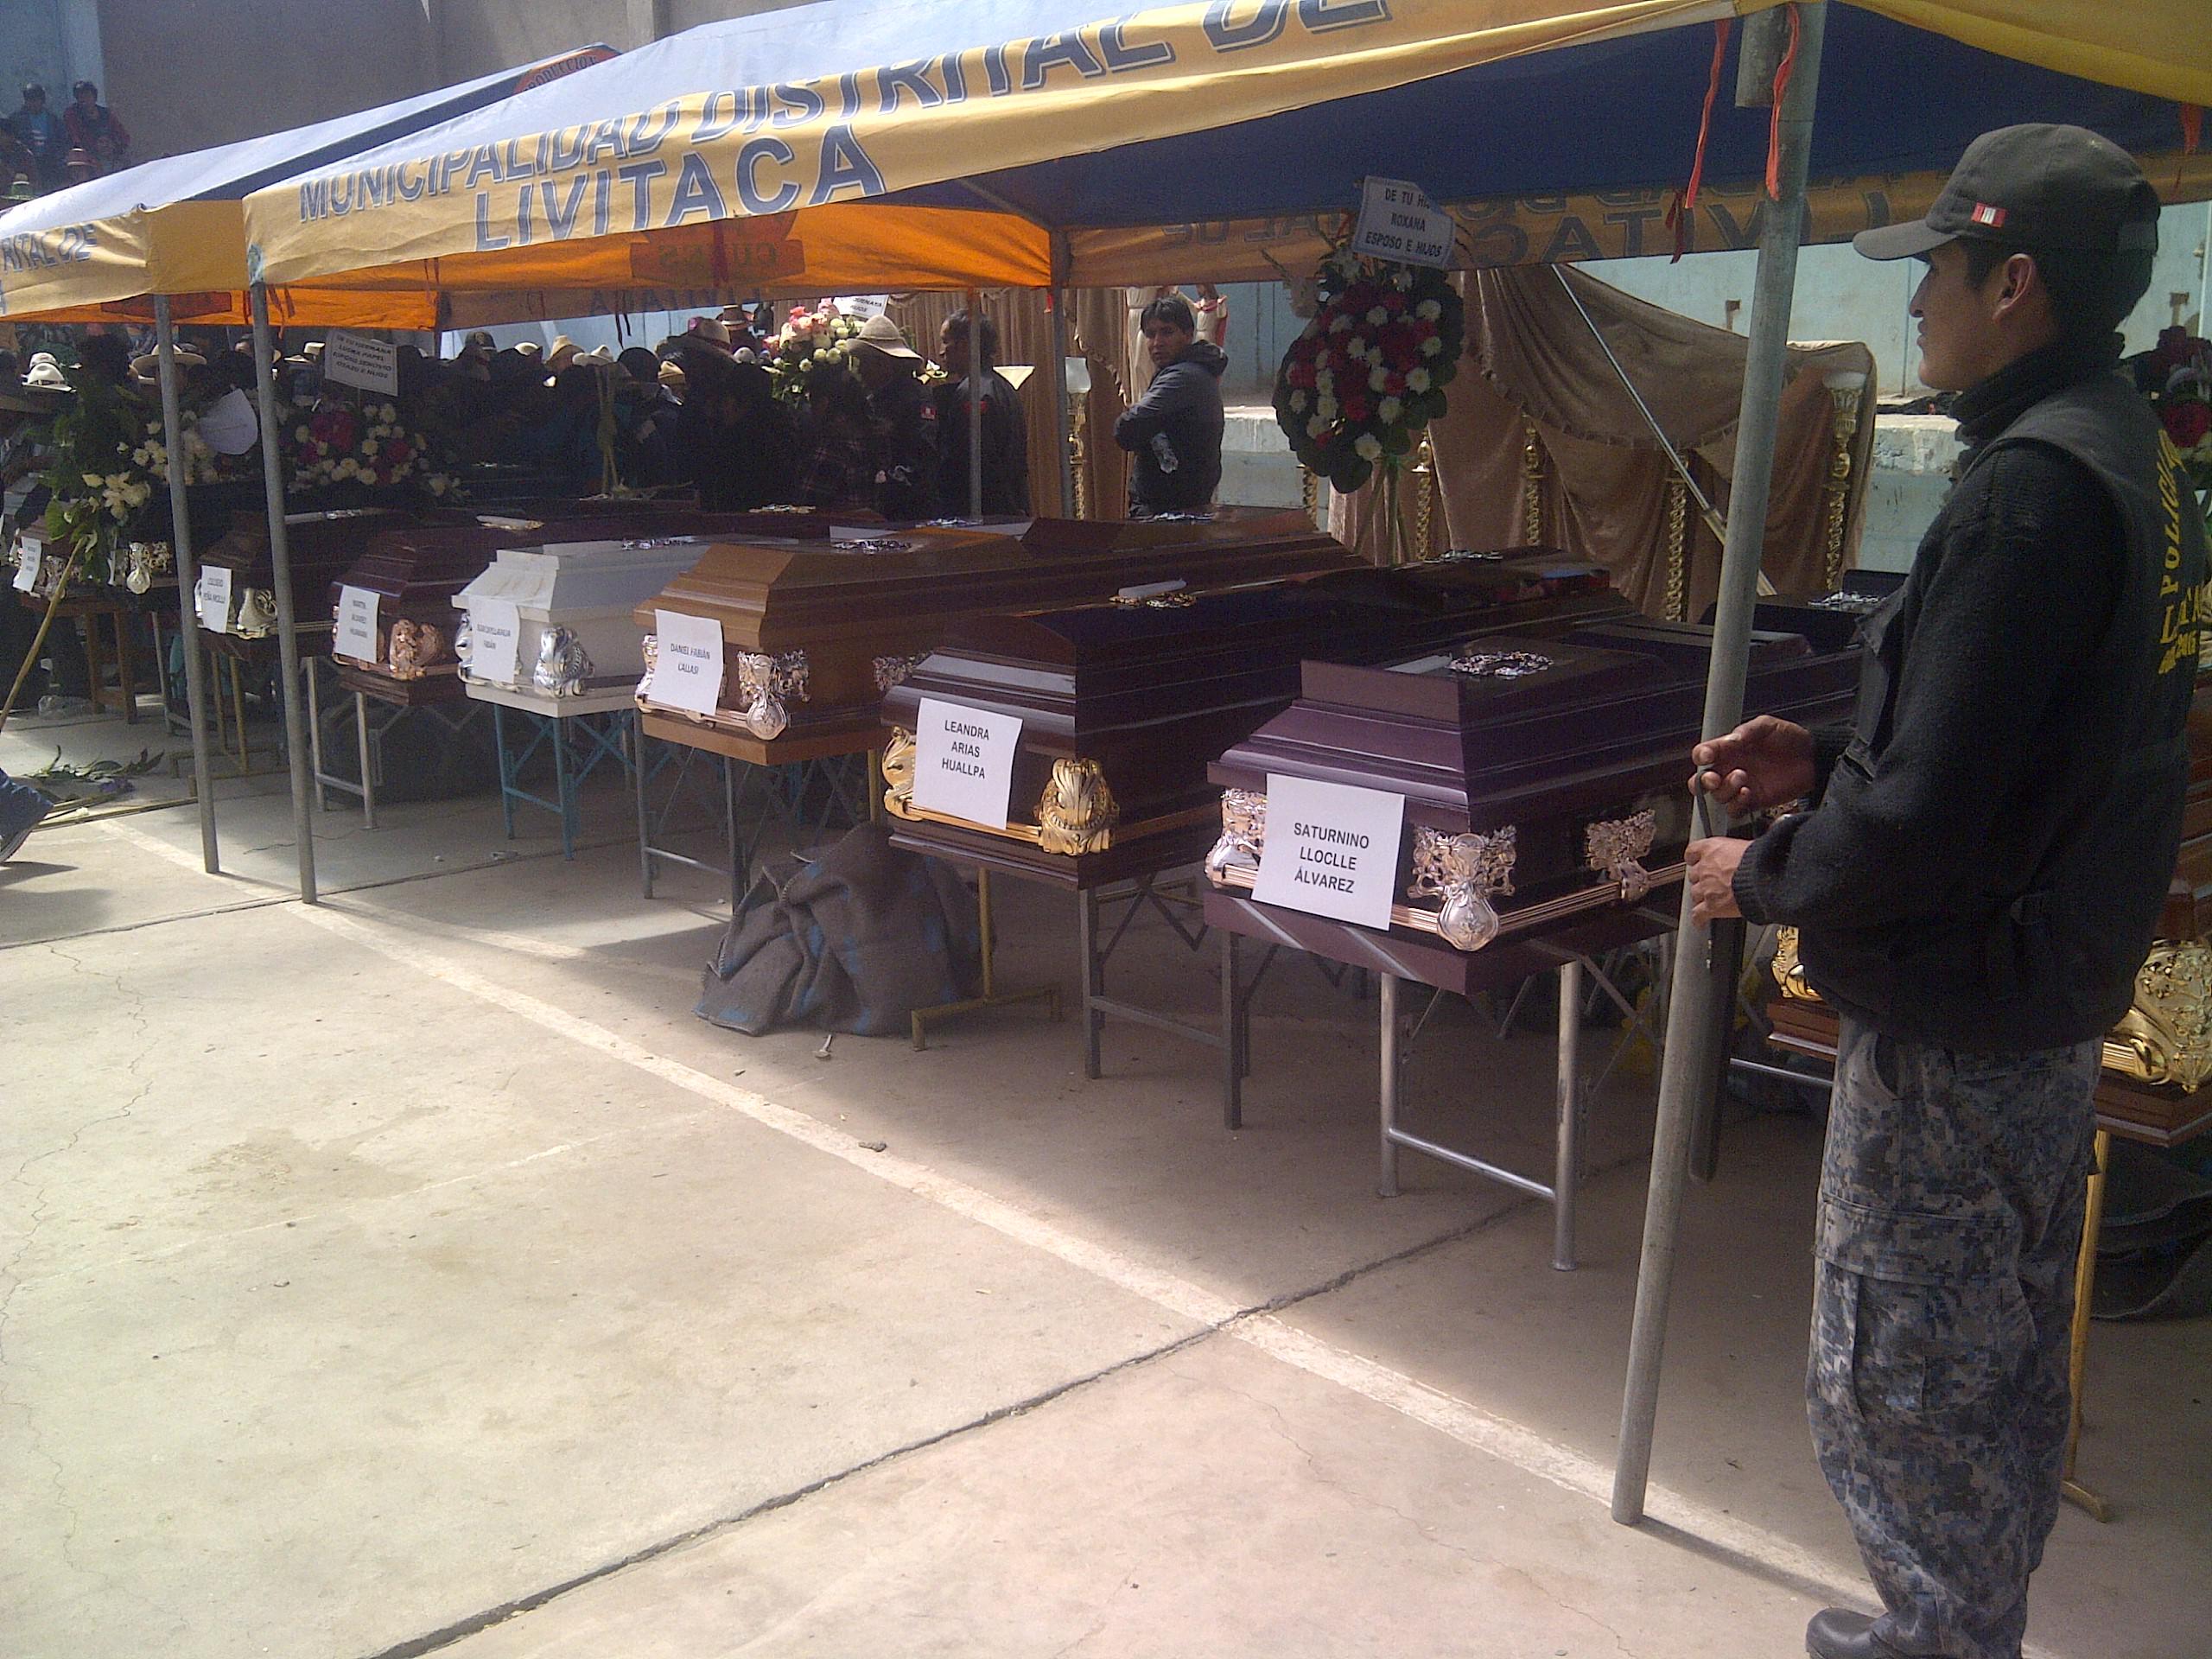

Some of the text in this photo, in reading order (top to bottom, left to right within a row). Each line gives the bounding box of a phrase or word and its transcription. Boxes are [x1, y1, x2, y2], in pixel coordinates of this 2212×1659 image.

[300, 99, 682, 223] MUNICIPALIDAD
[474, 123, 887, 251] LIVITACA
[1402, 191, 1414, 206] TU
[1365, 232, 1442, 257] ESPOSO E HIJOS
[671, 644, 689, 655] DANIEL
[944, 720, 989, 741] LEANDRA
[950, 741, 980, 758] ARIAS
[942, 758, 986, 779] HUALLPA
[1294, 823, 1370, 849] SATURNINO
[1300, 846, 1357, 870] LLOCLLE
[1294, 867, 1355, 893] ÁLVAREZ
